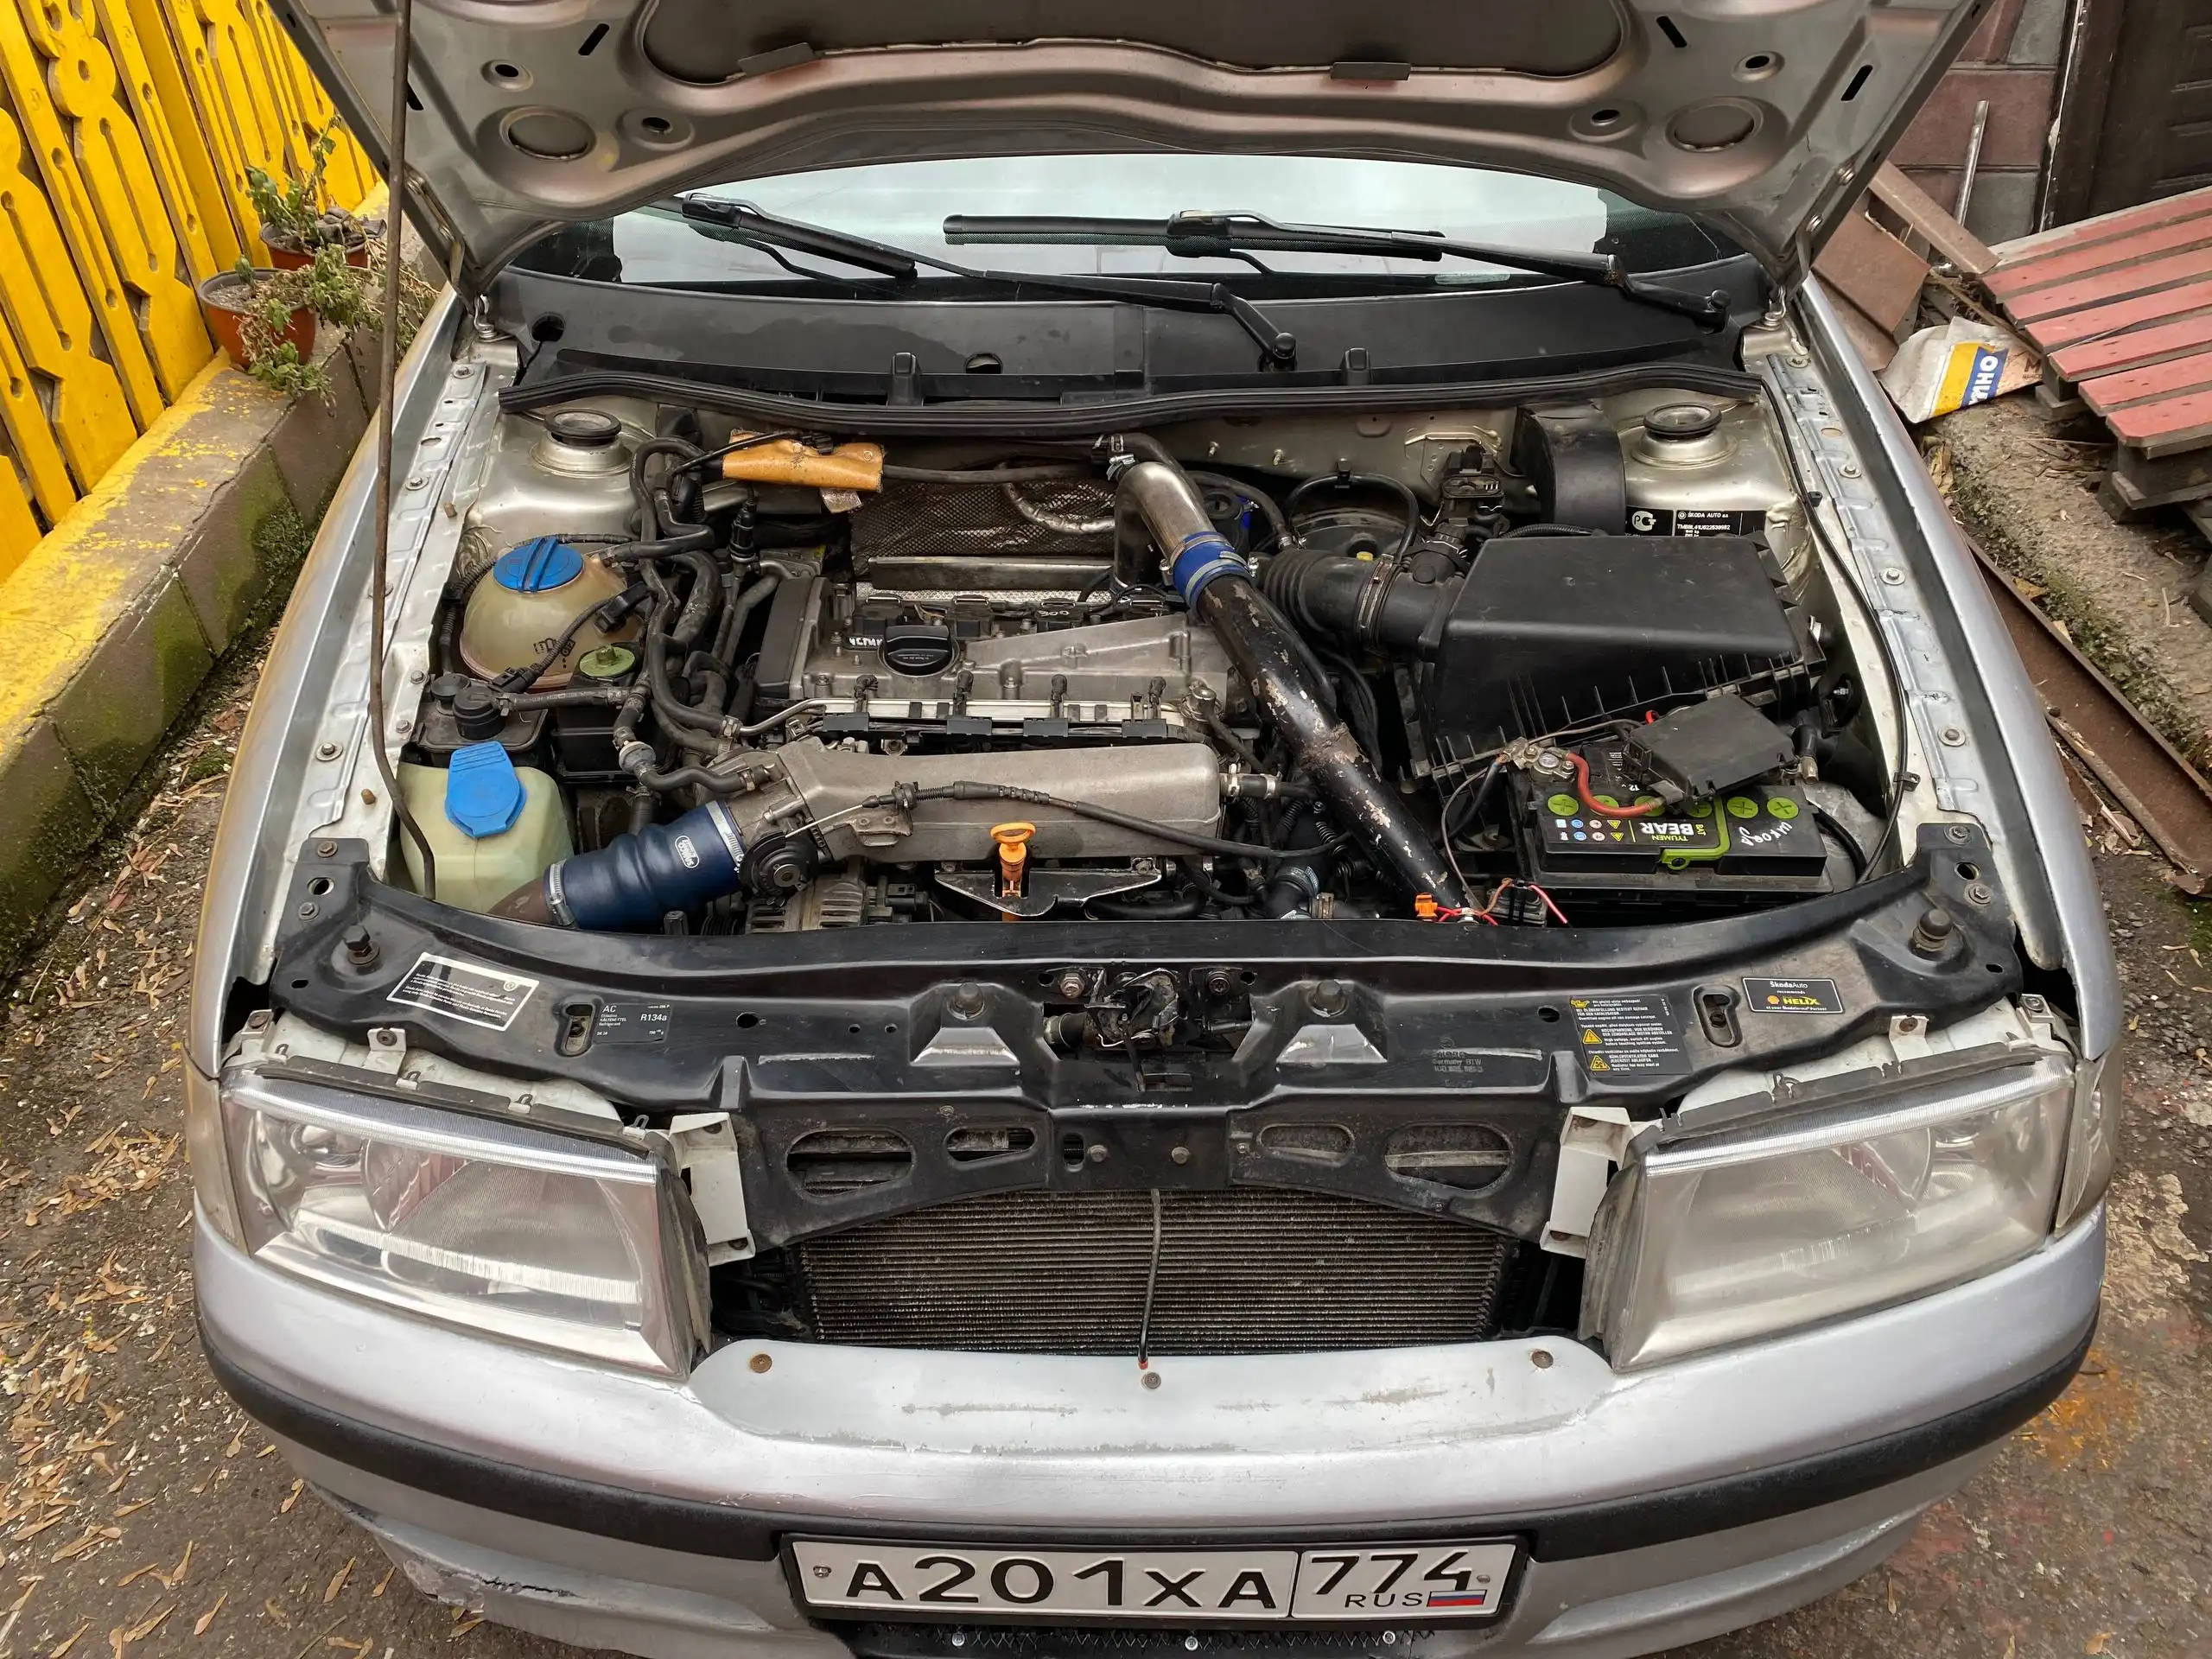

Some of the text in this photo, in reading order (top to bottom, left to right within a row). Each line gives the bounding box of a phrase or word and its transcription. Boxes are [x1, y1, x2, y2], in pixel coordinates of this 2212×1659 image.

[1639, 823, 1694, 836] BEAR
[1311, 1551, 1472, 1595] 774
[1344, 1592, 1423, 1608] RUS
